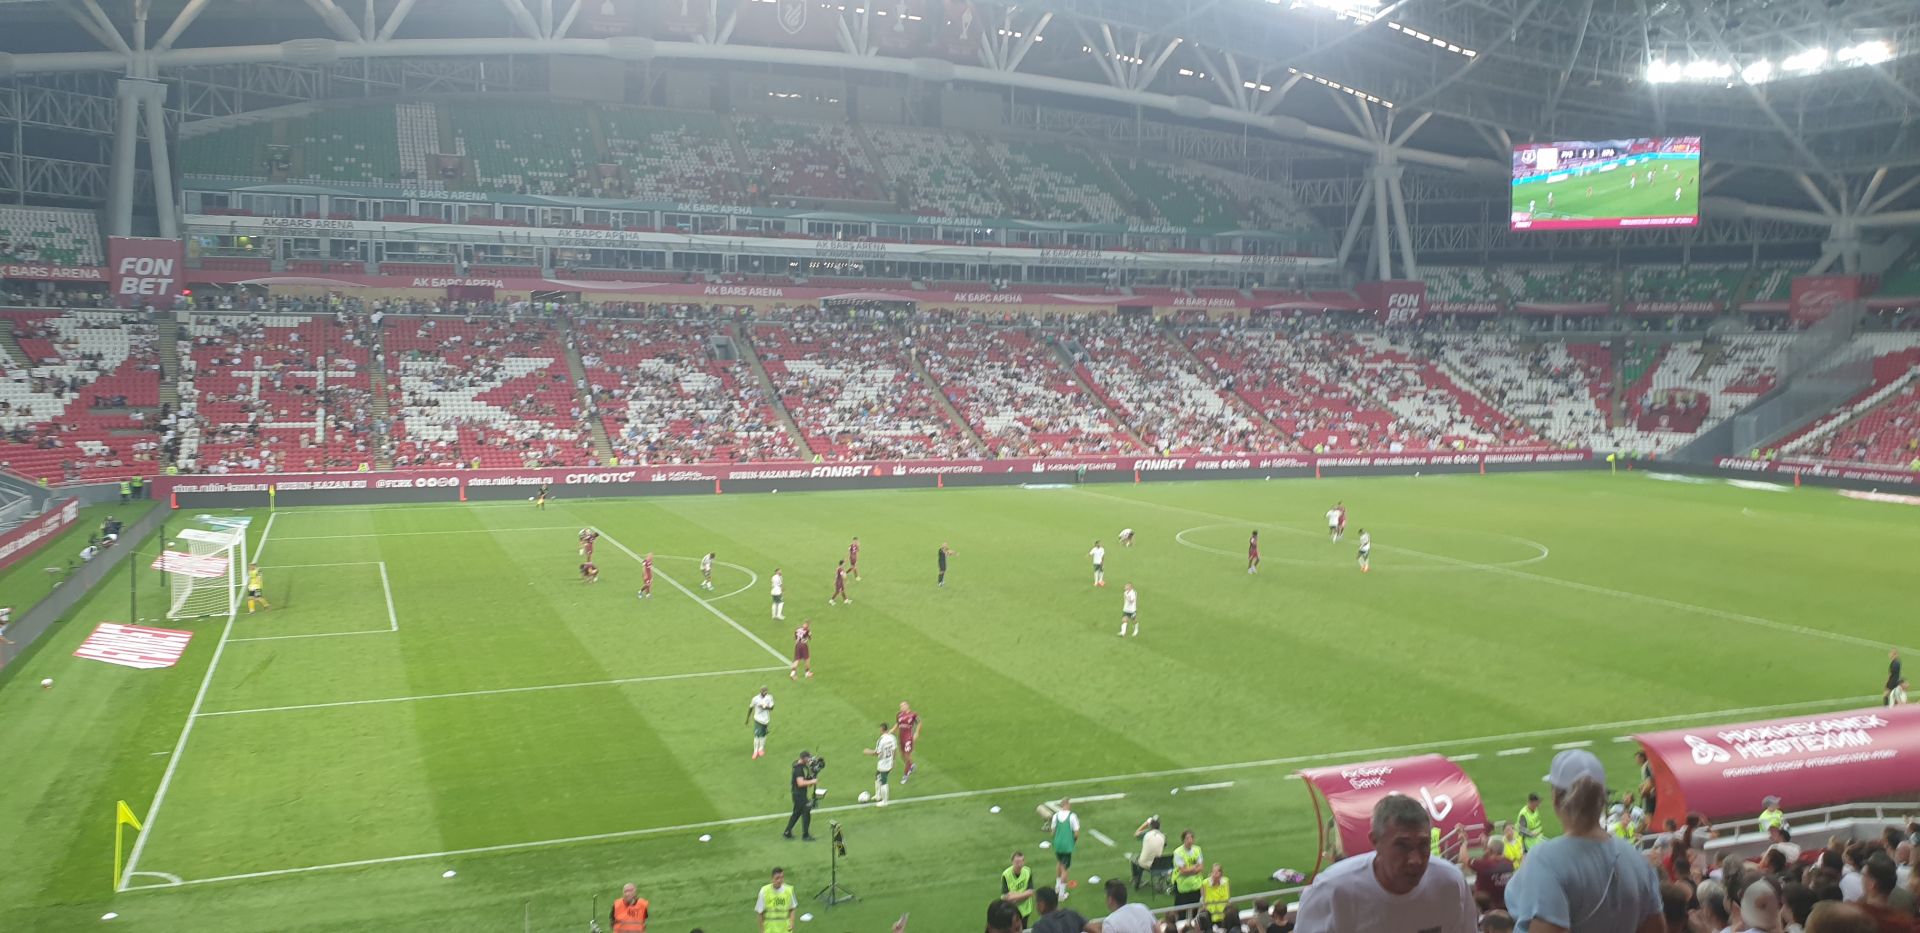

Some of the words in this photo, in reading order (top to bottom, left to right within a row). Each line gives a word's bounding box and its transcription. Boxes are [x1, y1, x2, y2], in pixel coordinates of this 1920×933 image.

[402, 189, 418, 198] AK
[419, 190, 448, 200] BARS
[451, 191, 488, 201] ARENA
[693, 204, 718, 212] БАРС
[720, 205, 752, 214] АРЕНА
[262, 218, 279, 227] AK
[281, 219, 312, 228] BARS
[315, 220, 354, 230] ARENA
[575, 230, 602, 239] БАРС
[605, 231, 640, 241] АРЕНА
[119, 257, 174, 275] FON
[9, 266, 49, 277] BARS
[52, 267, 101, 279] ARENA
[119, 277, 174, 296] BET
[412, 278, 429, 288] АК
[431, 278, 463, 287] БАРС
[704, 286, 719, 295] AK
[720, 287, 747, 296] BARS
[748, 288, 784, 297] ARENA
[1387, 293, 1420, 308] FON
[1387, 308, 1420, 321] BET
[1133, 459, 1187, 471] FONBET
[811, 465, 872, 478] FONBET
